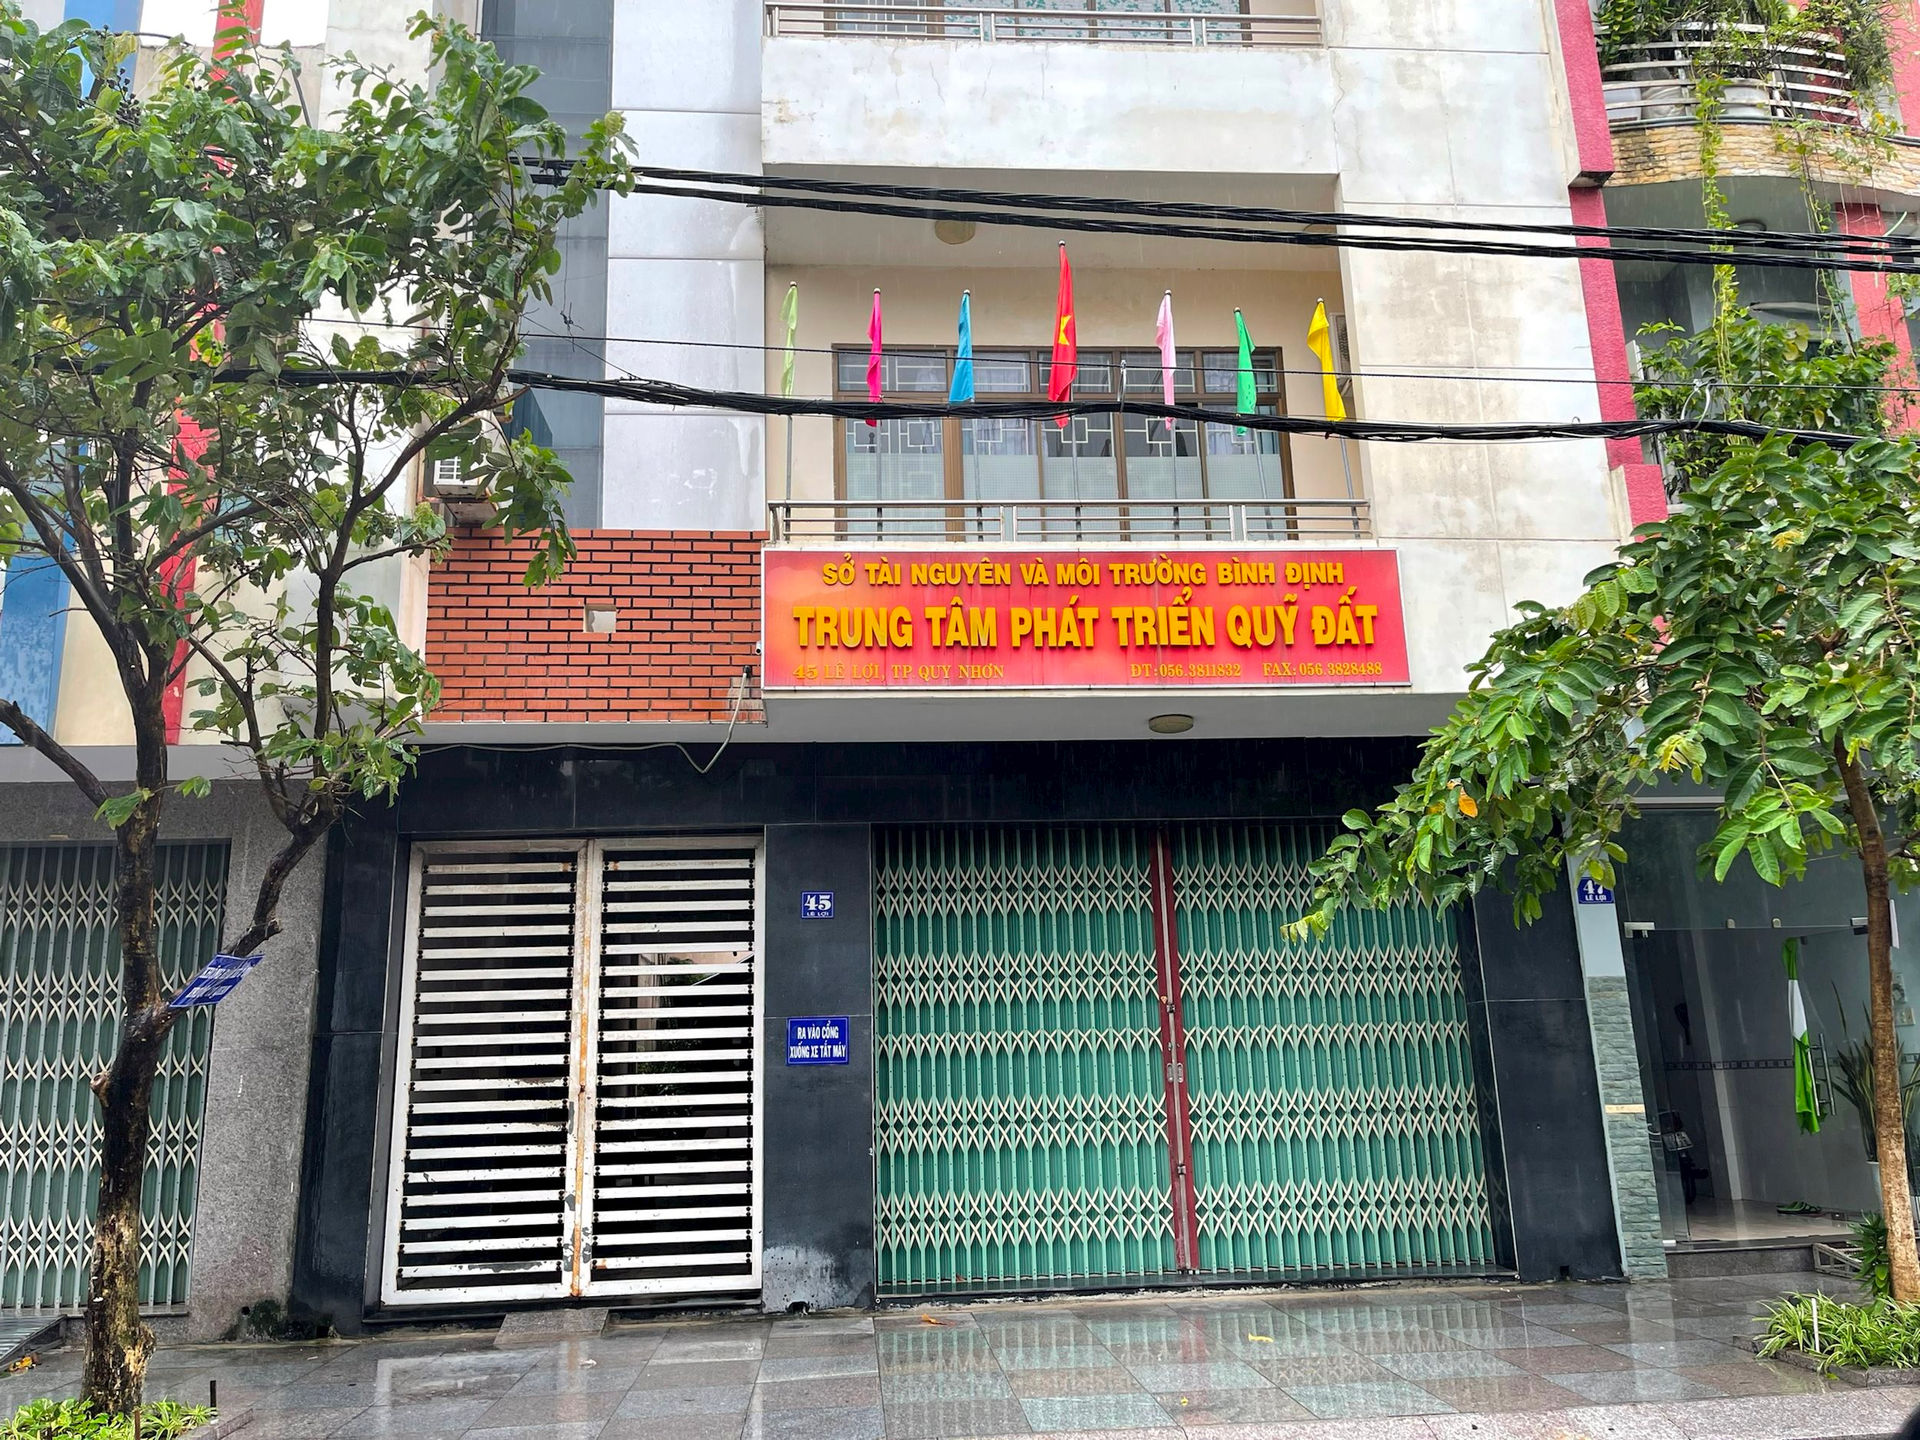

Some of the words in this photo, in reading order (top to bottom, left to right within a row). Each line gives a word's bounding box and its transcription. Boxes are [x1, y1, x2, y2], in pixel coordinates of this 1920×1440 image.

[822, 553, 856, 586] SỞ
[864, 557, 901, 586] TÀI
[911, 558, 1011, 586] NGUYÊN
[1019, 558, 1050, 586] VÀ
[1056, 558, 1100, 586] MÔI
[1108, 553, 1208, 586] TRƯỜNG
[1216, 557, 1276, 585] BÌNH
[1285, 562, 1344, 590] ĐỊNH
[793, 605, 913, 648] TRUNG
[925, 596, 998, 648] TÂM
[1010, 595, 1100, 648] PHÁT
[1111, 586, 1215, 647] TRIỂN
[1226, 593, 1299, 648] QUỸ
[1311, 586, 1378, 646] ĐẤT
[792, 664, 819, 679] 45
[824, 663, 845, 679] LÊ
[852, 663, 886, 682] LỢI,
[958, 663, 1005, 679] NHƠN
[804, 895, 832, 911] 45
[797, 1027, 806, 1039] RA
[807, 1024, 820, 1039] VÀO
[821, 1020, 839, 1039] CỔNG
[789, 1041, 810, 1058] XUỐNG
[810, 1045, 819, 1058] XE
[832, 1041, 846, 1058] MÁY
